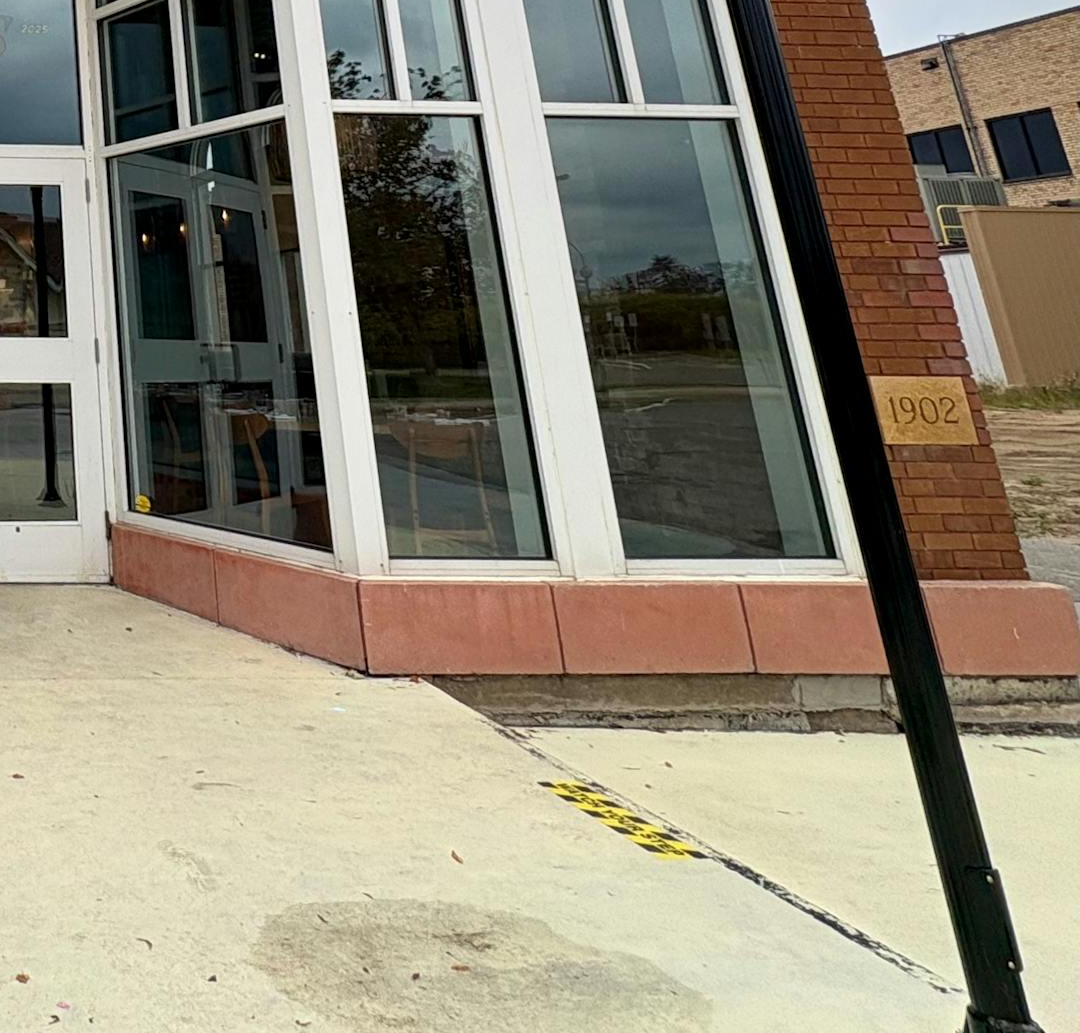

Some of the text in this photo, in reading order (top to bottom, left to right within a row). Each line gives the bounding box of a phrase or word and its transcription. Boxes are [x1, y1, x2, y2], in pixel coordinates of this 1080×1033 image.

[888, 396, 960, 425] 1902
[556, 782, 686, 856] WATCH YOUR STEP
